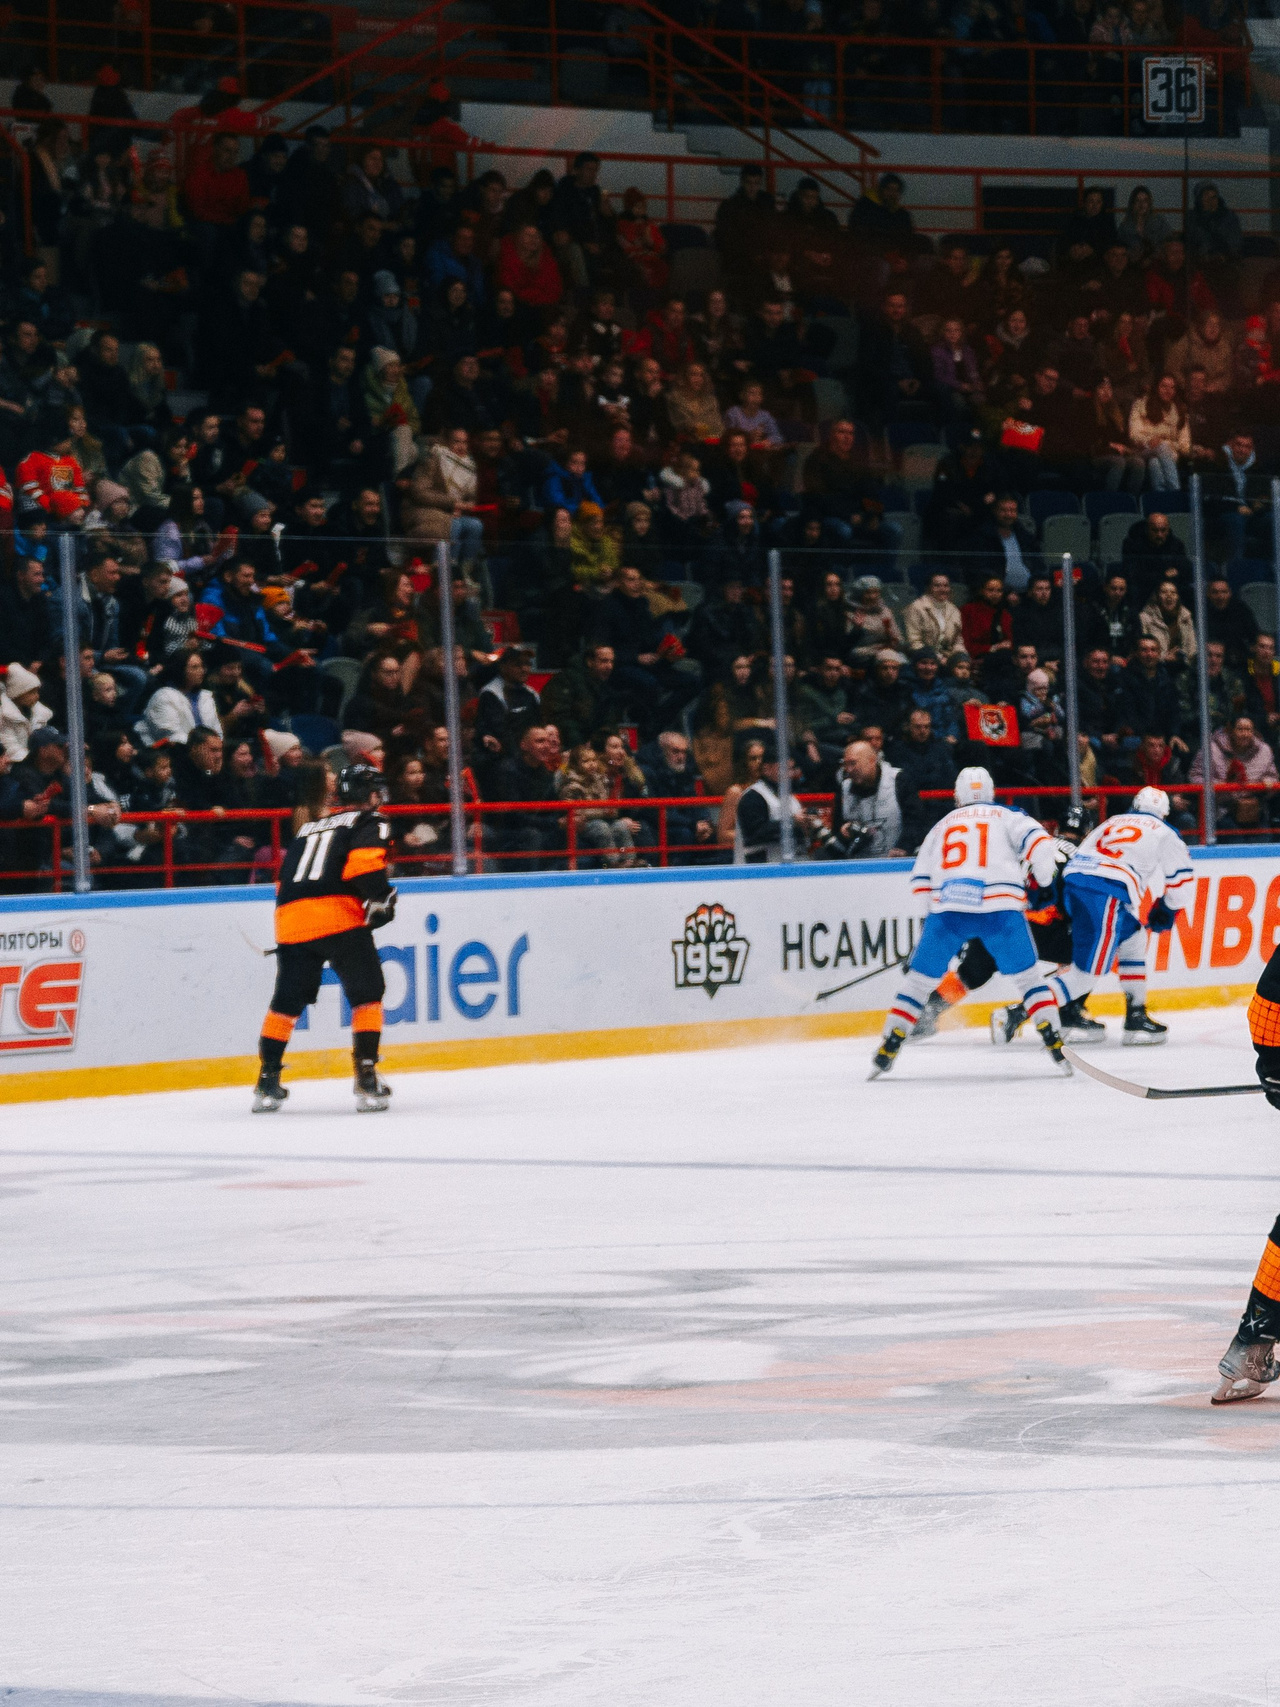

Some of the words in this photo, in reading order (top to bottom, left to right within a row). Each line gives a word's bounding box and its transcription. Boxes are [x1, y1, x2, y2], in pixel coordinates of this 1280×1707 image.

[1151, 67, 1197, 113] 36
[293, 828, 336, 883] 11
[941, 822, 989, 870] 61
[673, 938, 748, 986] 1957
[782, 917, 925, 971] HCAMU
